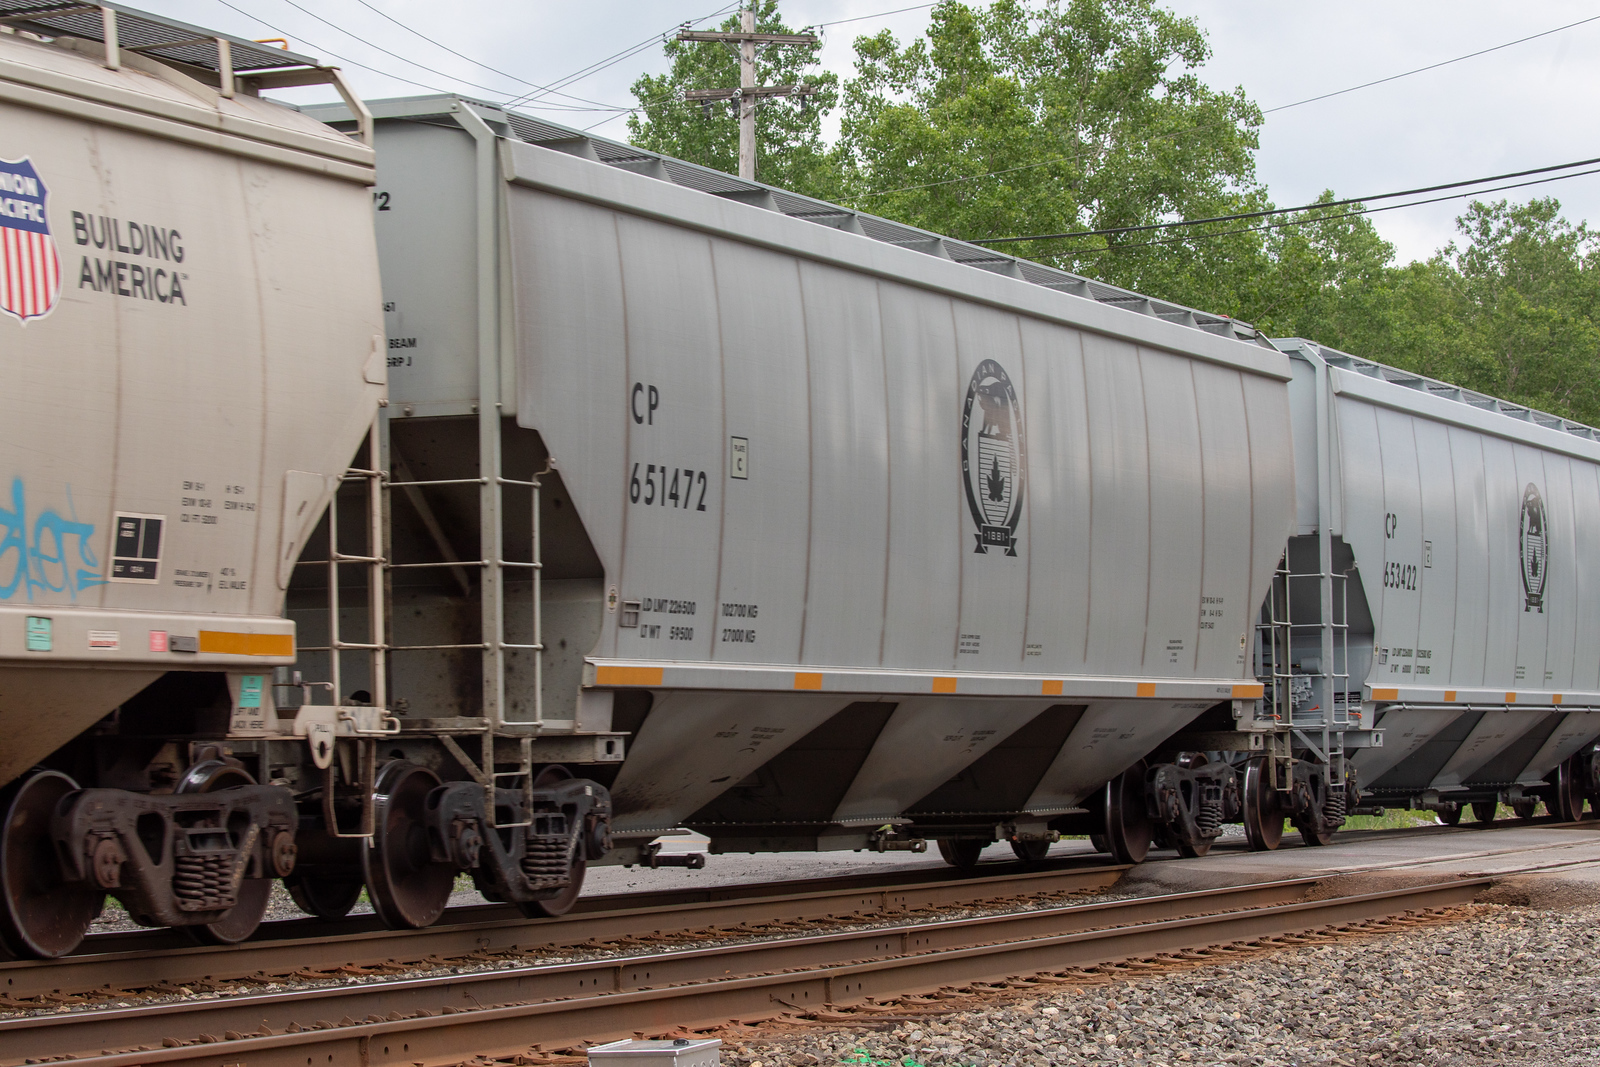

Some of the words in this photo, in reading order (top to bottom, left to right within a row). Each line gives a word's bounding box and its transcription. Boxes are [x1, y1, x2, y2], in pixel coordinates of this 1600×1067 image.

[0, 171, 39, 198] NION
[71, 210, 184, 264] BUILDING
[79, 255, 187, 307] AMERICA
[389, 338, 417, 349] BEAM
[631, 382, 659, 425] CP
[962, 363, 995, 472] CANADIAN
[737, 457, 742, 472] C
[630, 463, 707, 512] 651472
[987, 531, 1005, 542] 1881
[1385, 513, 1397, 540] CP
[1384, 562, 1417, 591] 653422
[642, 597, 652, 612] LD
[653, 598, 668, 613] LMT
[668, 599, 696, 616] 226500
[722, 603, 746, 617] 102700
[747, 604, 758, 619] KG
[649, 624, 661, 639] WT
[669, 626, 694, 641] 59500
[722, 628, 745, 643] 27000
[745, 629, 756, 644] KG
[249, 720, 265, 730] HERE
